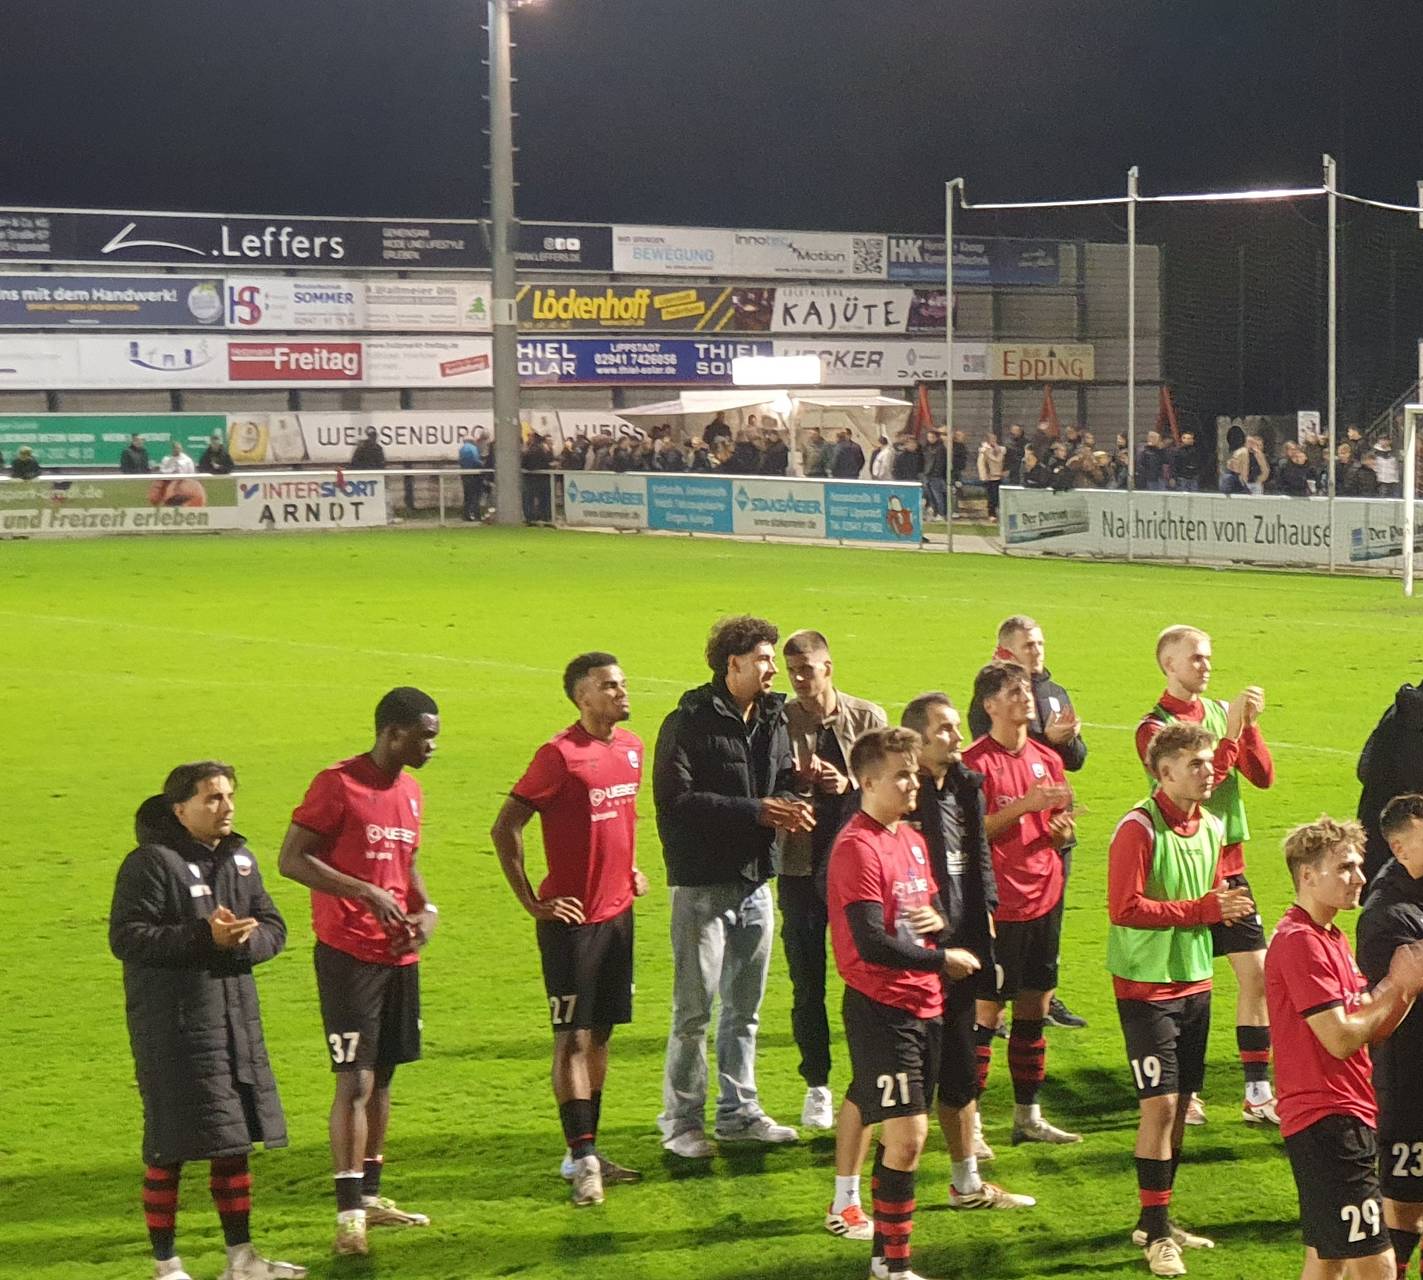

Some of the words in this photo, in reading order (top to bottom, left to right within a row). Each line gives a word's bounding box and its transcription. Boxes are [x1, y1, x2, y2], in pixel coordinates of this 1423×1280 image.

[632, 247, 714, 262] BEWEGUNG
[798, 251, 846, 262] Motion
[53, 287, 90, 301] dem
[92, 288, 177, 302] Handwerk!
[294, 291, 354, 304] SOMMER
[533, 288, 651, 320] Löckenhoff
[783, 296, 901, 330] KAJÜTE
[274, 348, 358, 375] Freitag
[3, 513, 42, 530] und
[50, 510, 128, 528] Freizeit
[133, 508, 209, 526] erleben
[259, 501, 364, 523] ARNDT
[1213, 519, 1249, 544] von
[1253, 514, 1331, 548] Zuhause
[550, 995, 577, 1025] 27
[328, 1032, 361, 1064] 37
[1131, 1056, 1161, 1089] 19
[877, 1073, 911, 1107] 21
[1341, 1199, 1381, 1243] 29
